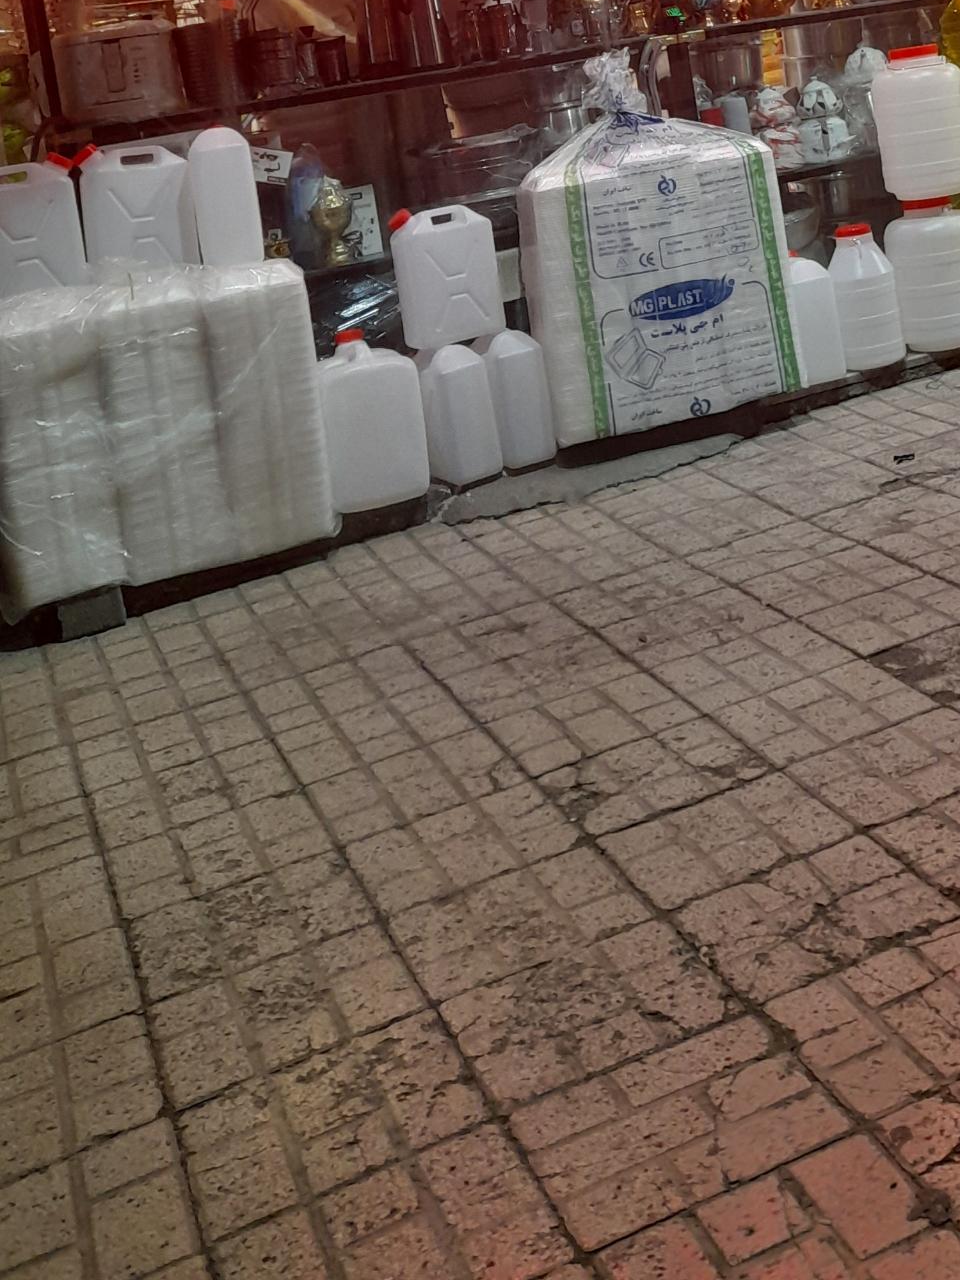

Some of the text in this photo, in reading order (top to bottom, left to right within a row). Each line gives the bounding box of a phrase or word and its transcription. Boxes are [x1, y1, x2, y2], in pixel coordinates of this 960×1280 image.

[630, 289, 702, 317] MG PLAST
[712, 313, 724, 328] ام
